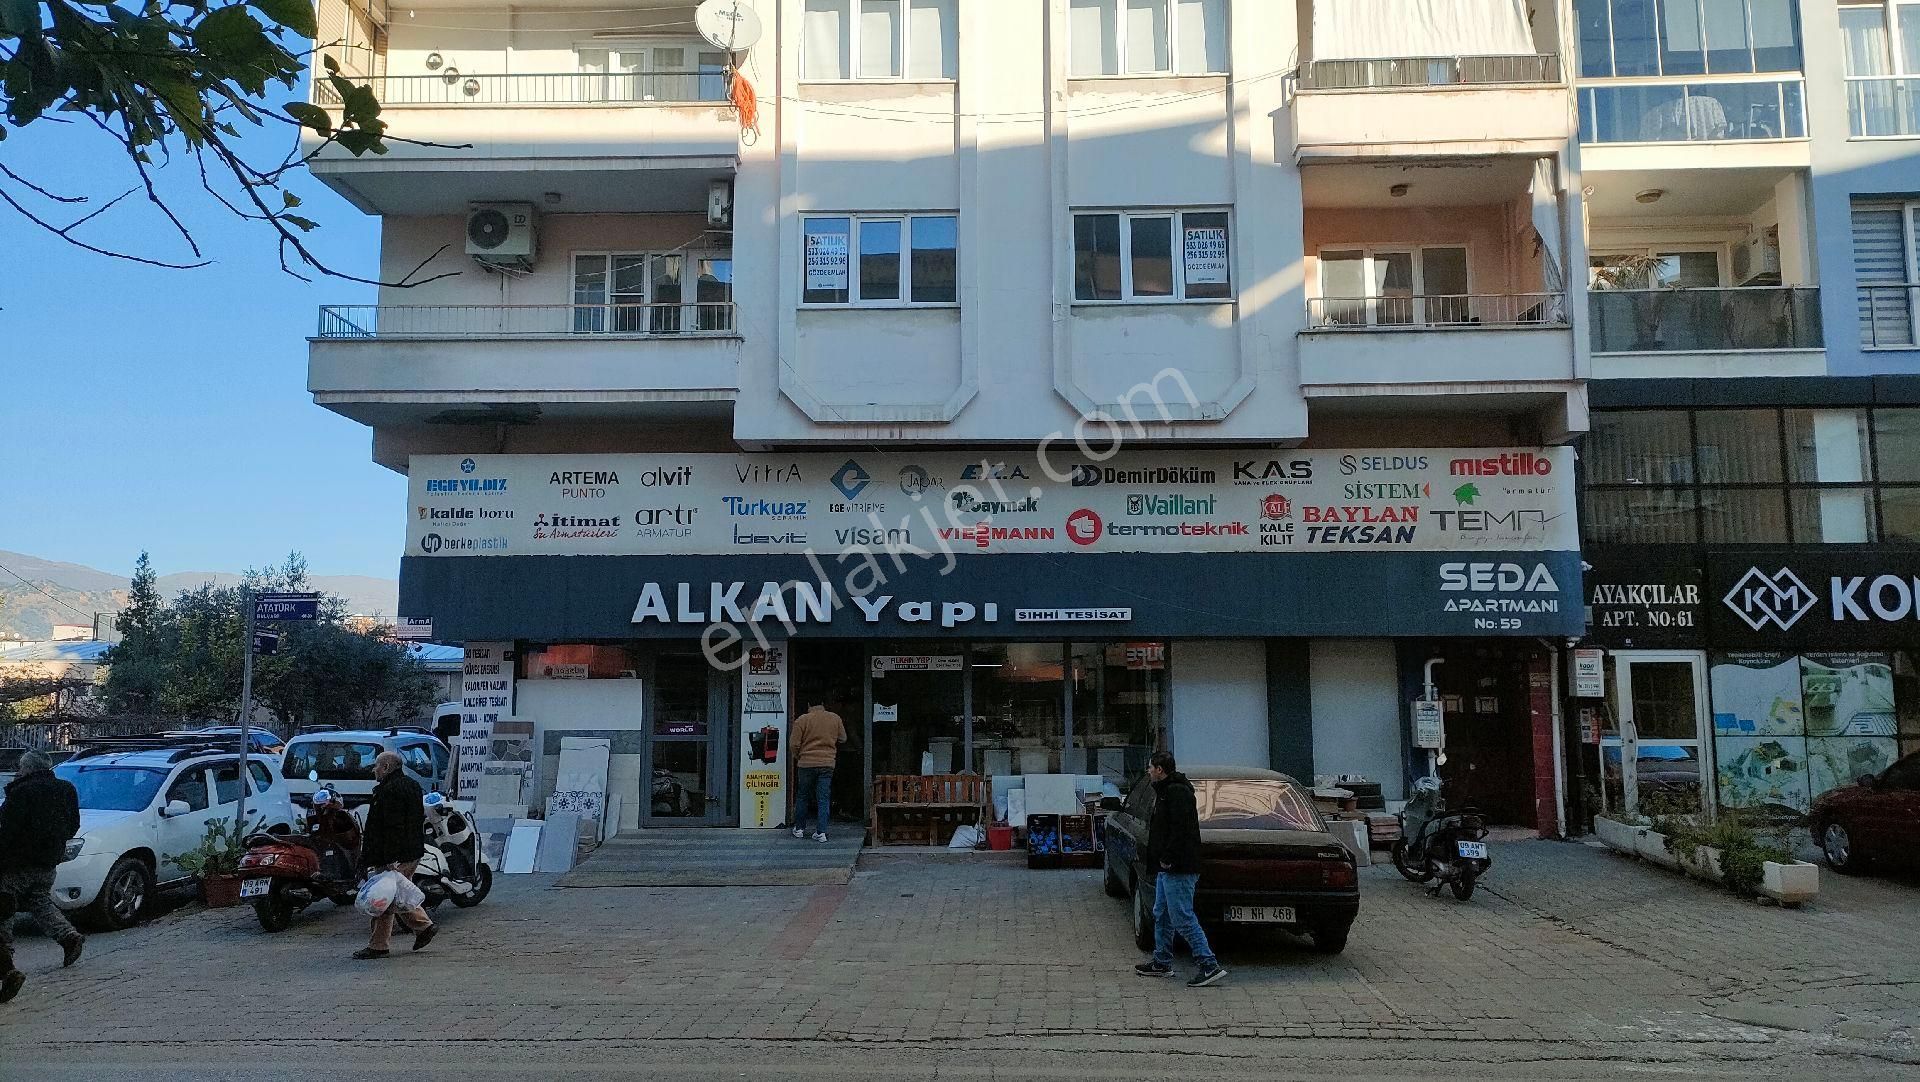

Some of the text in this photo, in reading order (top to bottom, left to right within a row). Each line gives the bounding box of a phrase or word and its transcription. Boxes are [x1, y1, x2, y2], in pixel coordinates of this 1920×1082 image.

[810, 236, 846, 246] SATILIK
[1187, 230, 1223, 240] SATILIK
[1361, 456, 1429, 471] SELDUS
[549, 471, 620, 486] ARTEMA
[640, 465, 692, 487] alvit
[735, 463, 802, 484] VitrA
[1103, 466, 1217, 485] DemirDöküm
[562, 488, 606, 499] PUNTO
[1343, 481, 1421, 500] SİSTEM
[721, 496, 808, 516] Turkuaz
[829, 503, 845, 513] EGE
[1144, 493, 1218, 516] Vaillant
[430, 507, 515, 519] kalde boru
[1302, 506, 1420, 523] BAYLAN
[1107, 521, 1250, 536] termoteknik
[1259, 523, 1294, 533] KALE
[1306, 525, 1417, 544] TEKSAN
[444, 536, 508, 551] berkeplastik
[1439, 562, 1560, 592] SEDA
[1592, 584, 1701, 609] AYAKÇILAR
[1830, 574, 1920, 622] KO
[256, 602, 297, 613] ATATÜRK
[631, 581, 1128, 628] ALKAN Yapı SIHHİ TESİSAT
[1443, 598, 1558, 613] APARTMANI
[1474, 617, 1522, 630] No: 59
[1602, 610, 1695, 627] APT. NO:61
[1231, 906, 1243, 920] 09
[1251, 907, 1265, 920] NH
